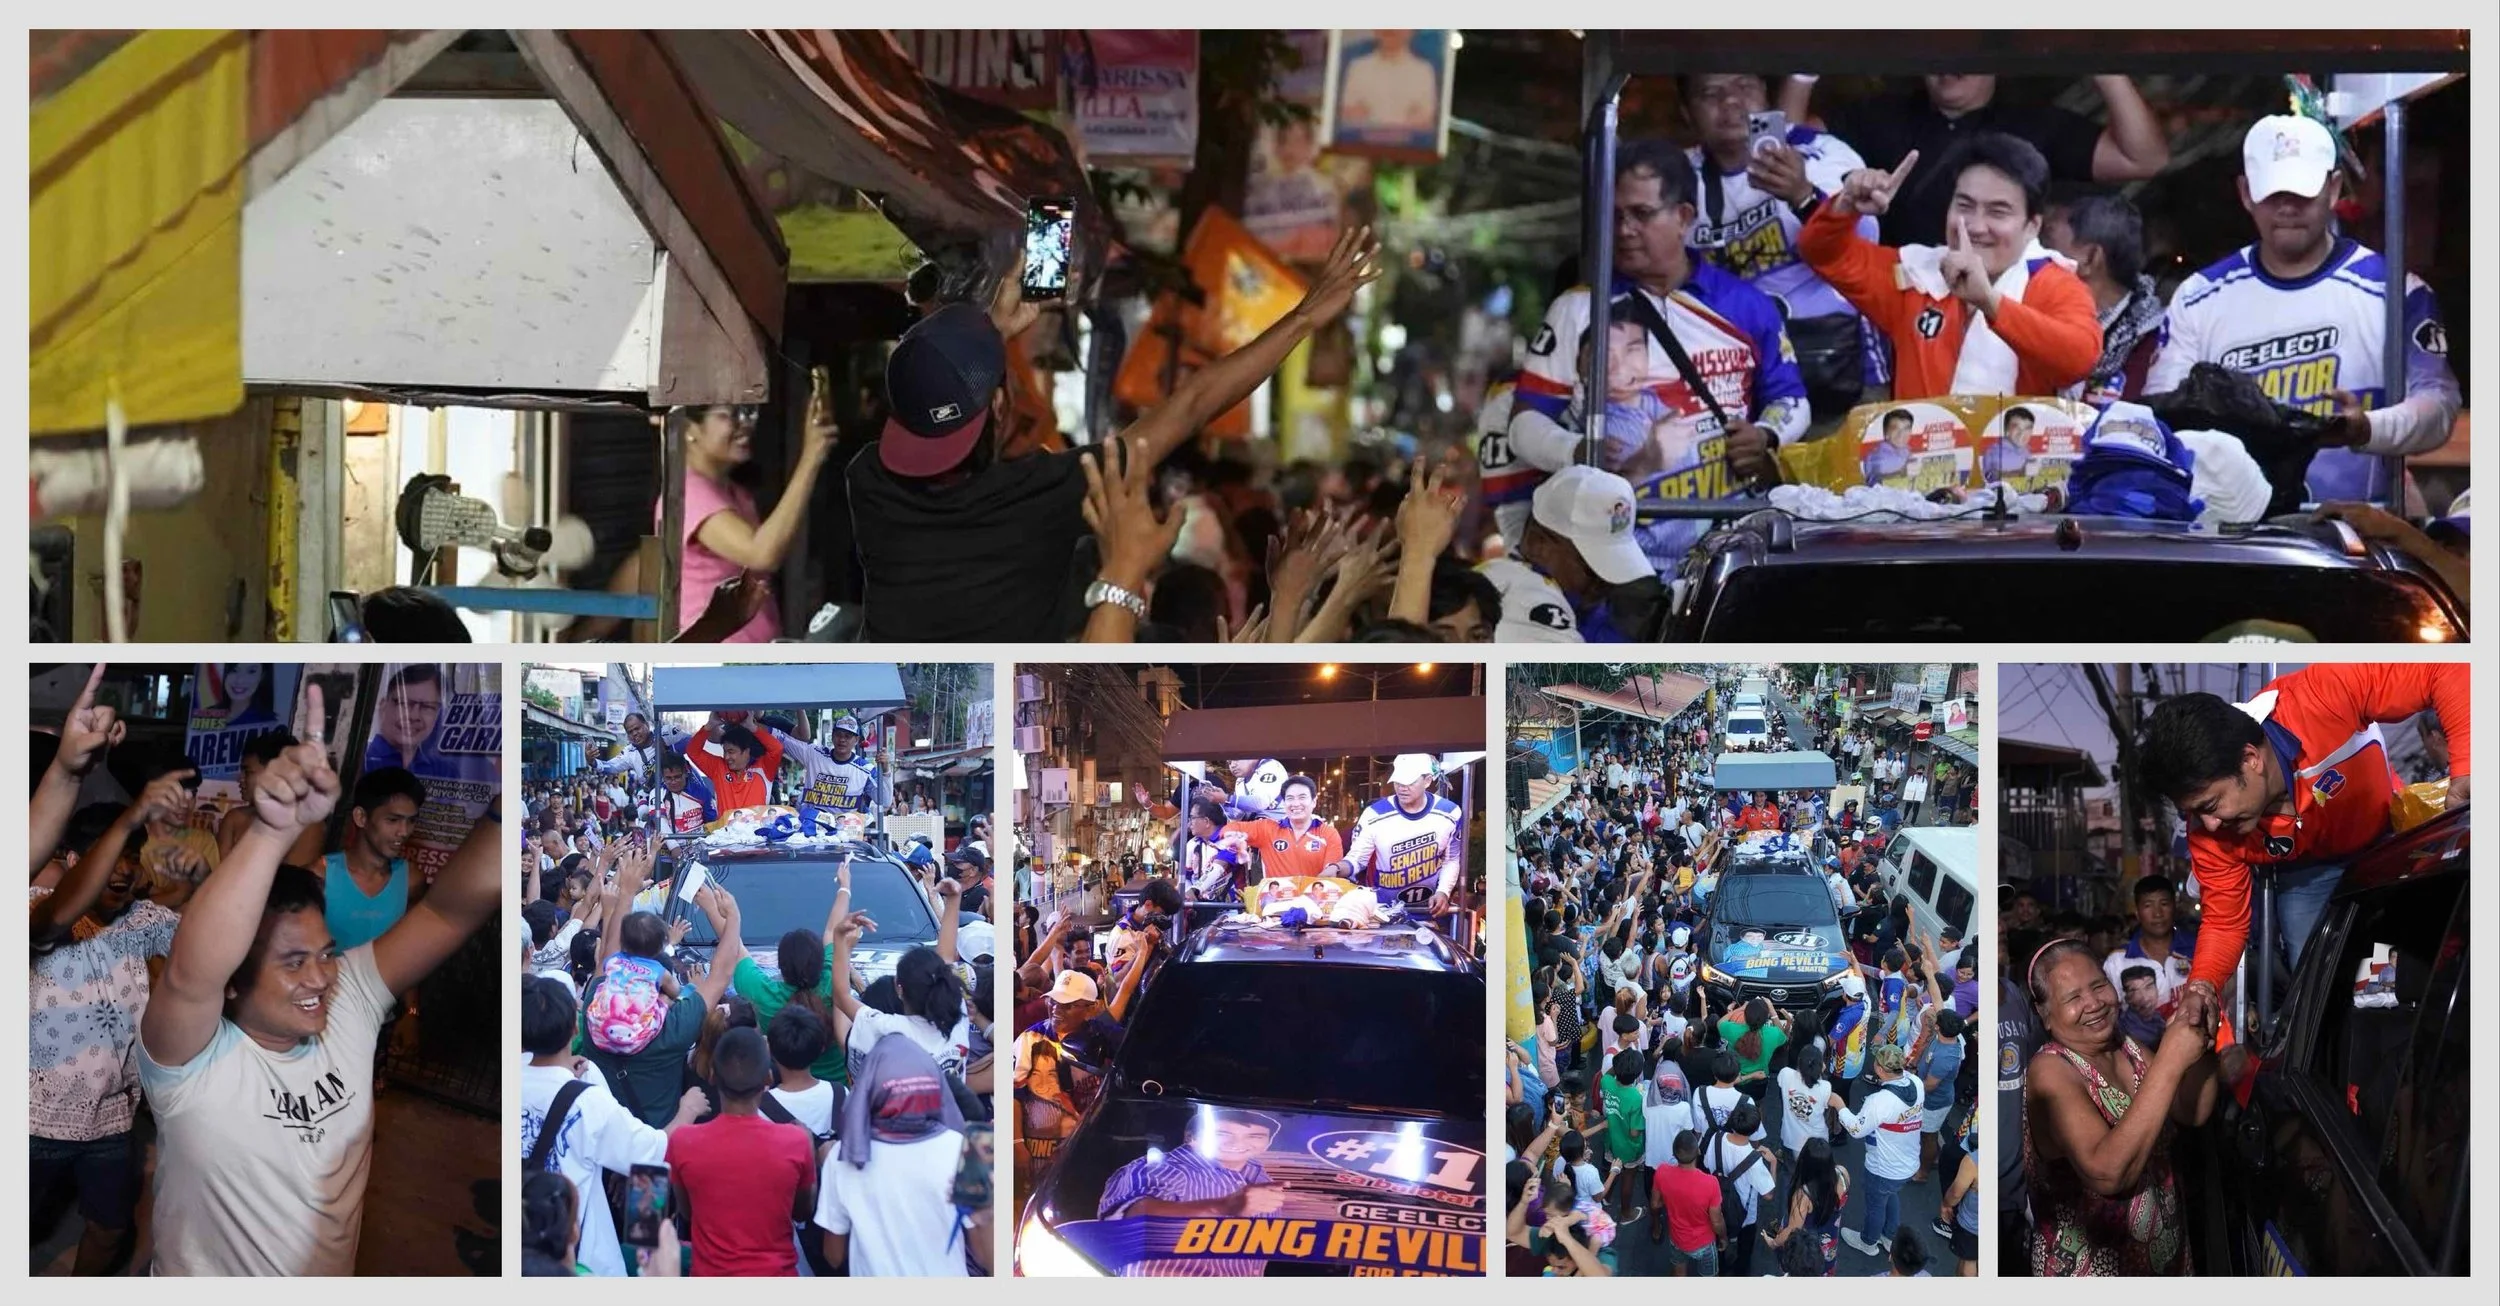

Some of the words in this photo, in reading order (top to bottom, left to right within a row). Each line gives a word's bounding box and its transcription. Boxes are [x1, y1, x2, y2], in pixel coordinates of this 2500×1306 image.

[440, 726, 502, 752] GARI
[1275, 841, 1286, 850] 11
[1391, 844, 1437, 871] SENATOR
[1407, 888, 1424, 903] 11
[1778, 933, 1818, 947] #11
[1745, 957, 1779, 969] BONG
[1780, 955, 1830, 967] REVILLA
[1173, 1218, 1316, 1257] BONG
